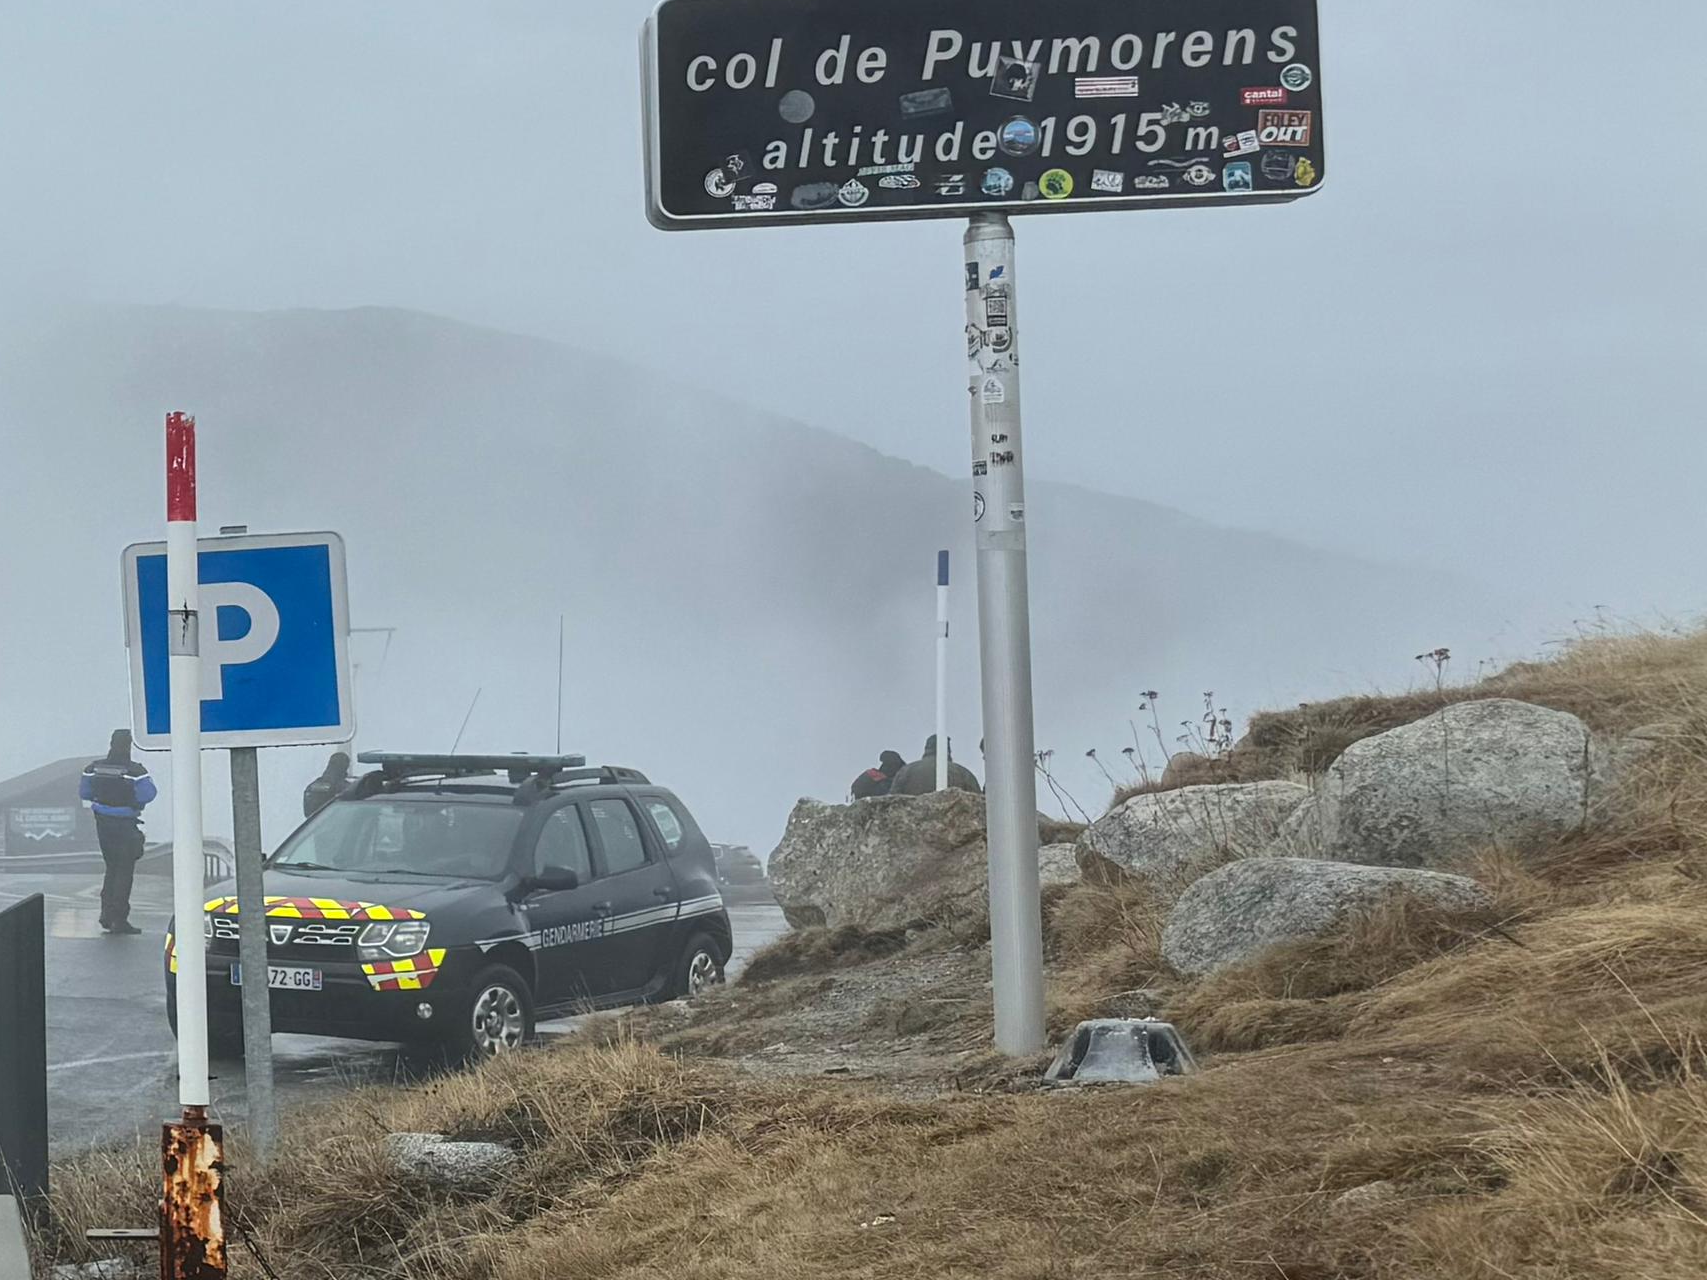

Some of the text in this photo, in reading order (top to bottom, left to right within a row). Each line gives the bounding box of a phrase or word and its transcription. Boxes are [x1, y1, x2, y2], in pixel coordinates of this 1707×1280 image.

[686, 37, 783, 92] col
[814, 34, 887, 86] de
[762, 112, 1220, 171] altitude 1915 m
[1259, 126, 1308, 142] OUT
[197, 581, 281, 700] P
[542, 919, 603, 948] GENDARMERIE
[268, 969, 312, 987] 72-GG
